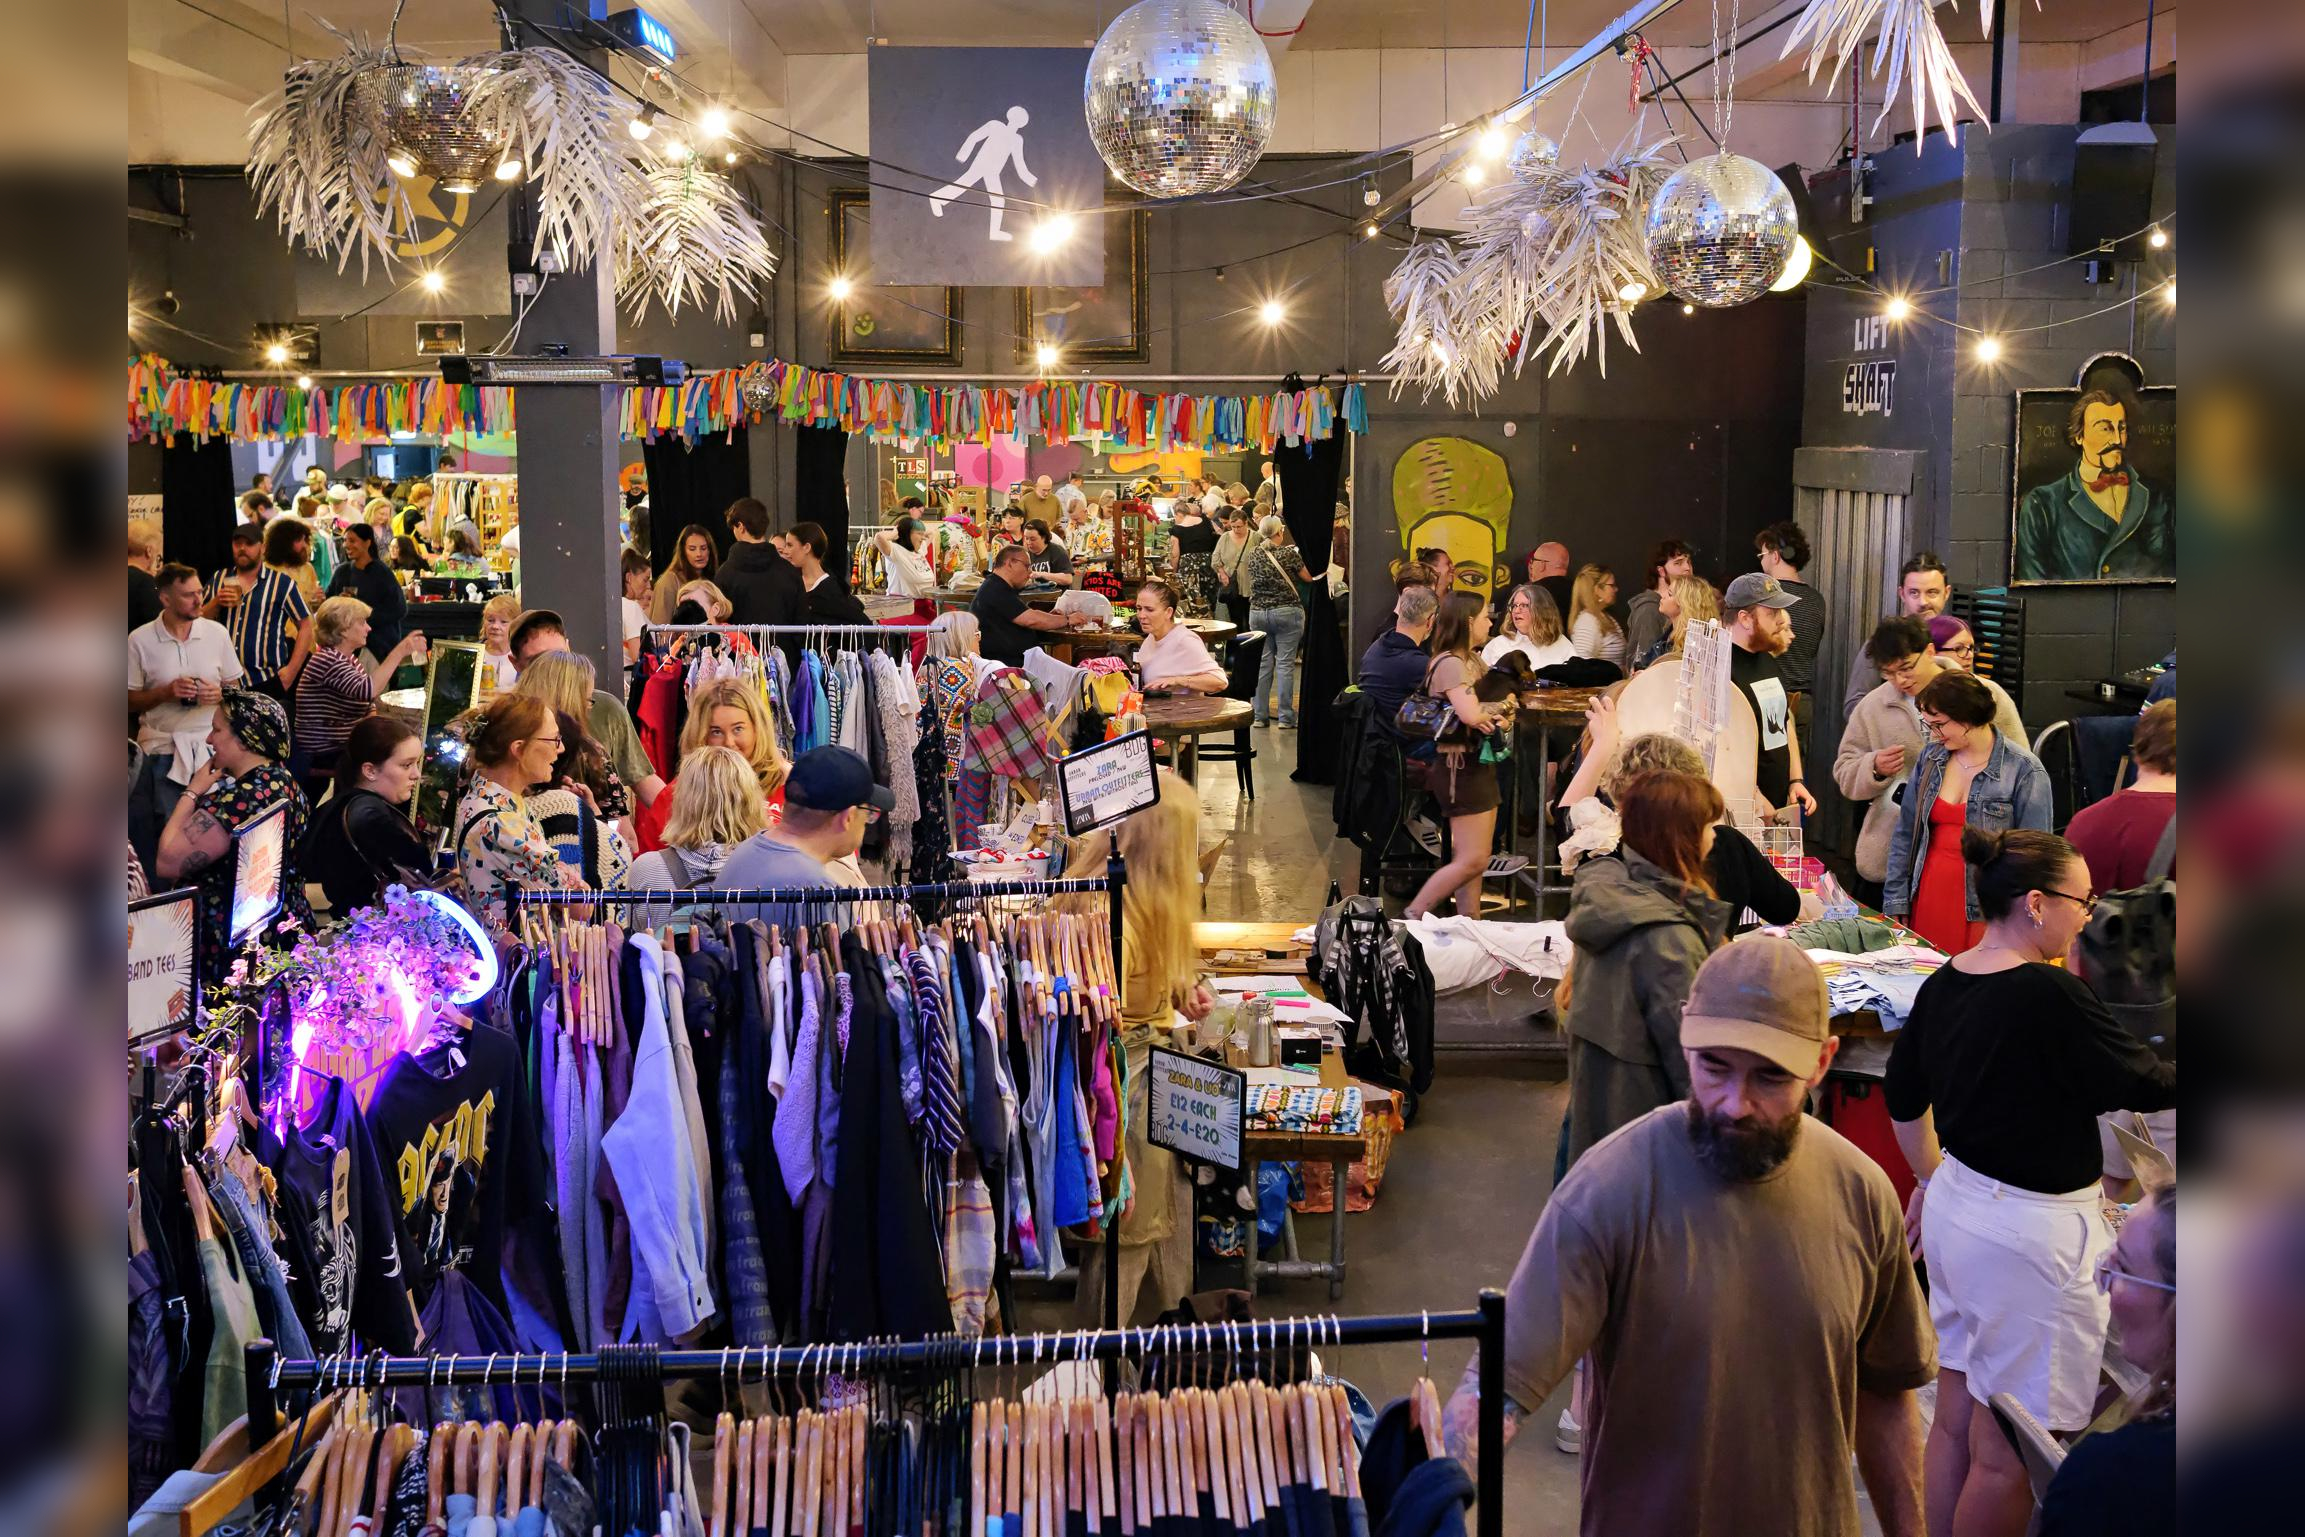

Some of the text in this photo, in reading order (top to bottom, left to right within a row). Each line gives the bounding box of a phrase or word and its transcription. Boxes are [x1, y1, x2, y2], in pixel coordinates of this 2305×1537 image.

[1854, 314, 1889, 351] LIFT
[1843, 360, 1896, 416] SHAFT
[897, 461, 925, 472] TLS
[1107, 578, 1122, 589] ARE
[157, 953, 176, 975] TEES
[1168, 1070, 1193, 1089] ZARA
[1190, 1098, 1217, 1121] EACH
